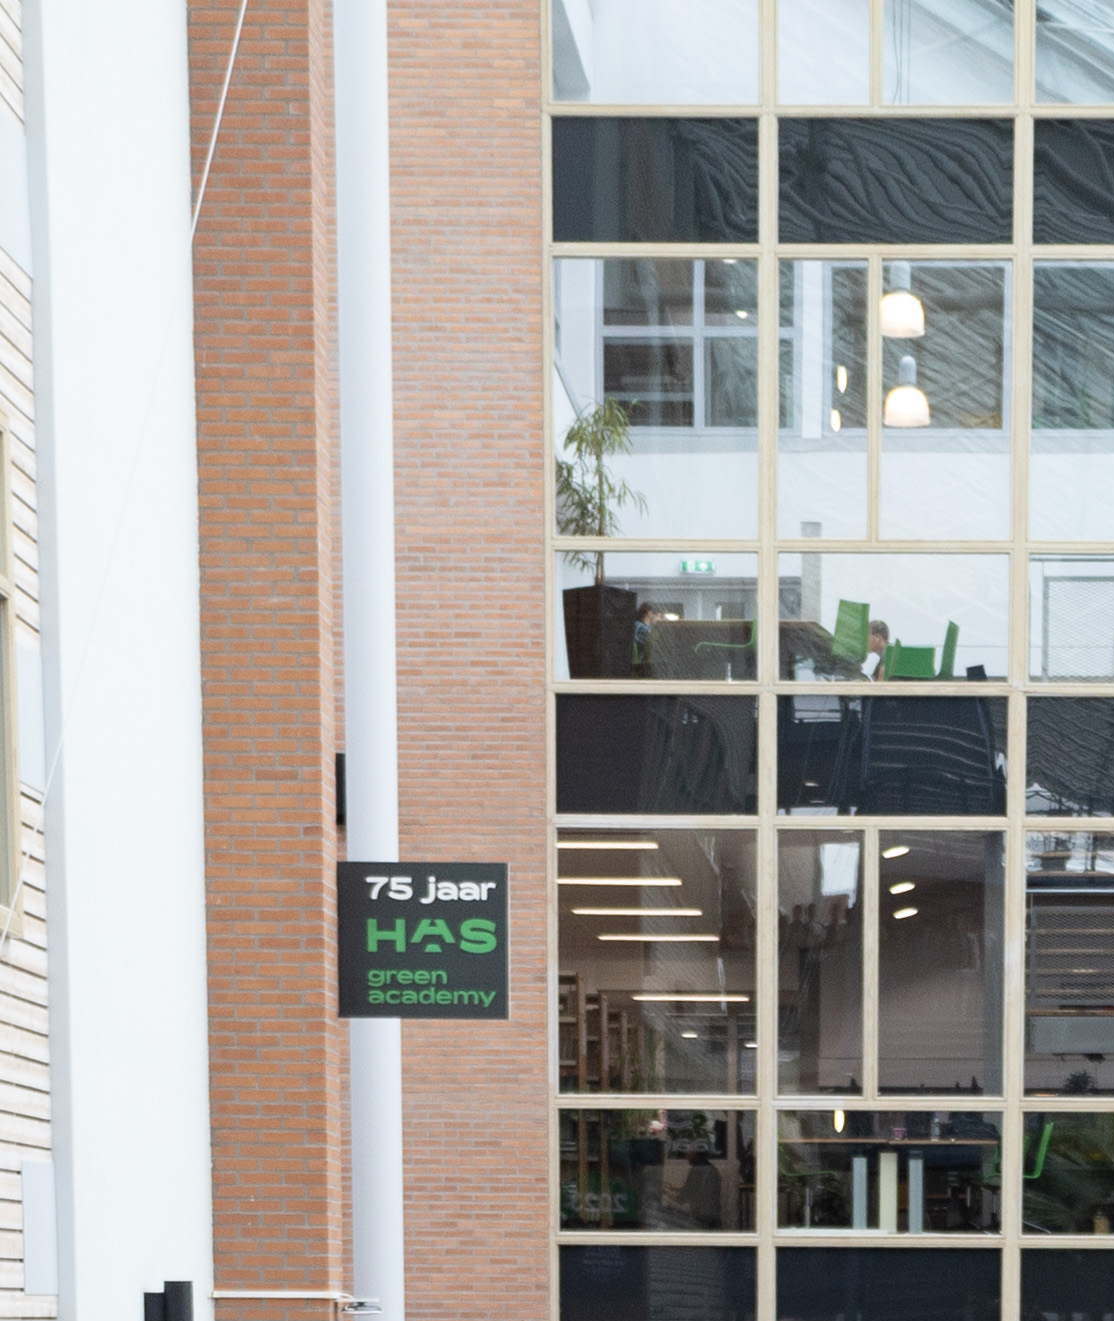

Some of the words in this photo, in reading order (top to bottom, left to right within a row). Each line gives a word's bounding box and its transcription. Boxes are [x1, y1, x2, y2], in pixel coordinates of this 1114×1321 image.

[365, 876, 413, 900] 75
[419, 876, 497, 904] jaar
[366, 918, 497, 954] HAS
[367, 969, 447, 987] green
[368, 987, 496, 1008] academy
